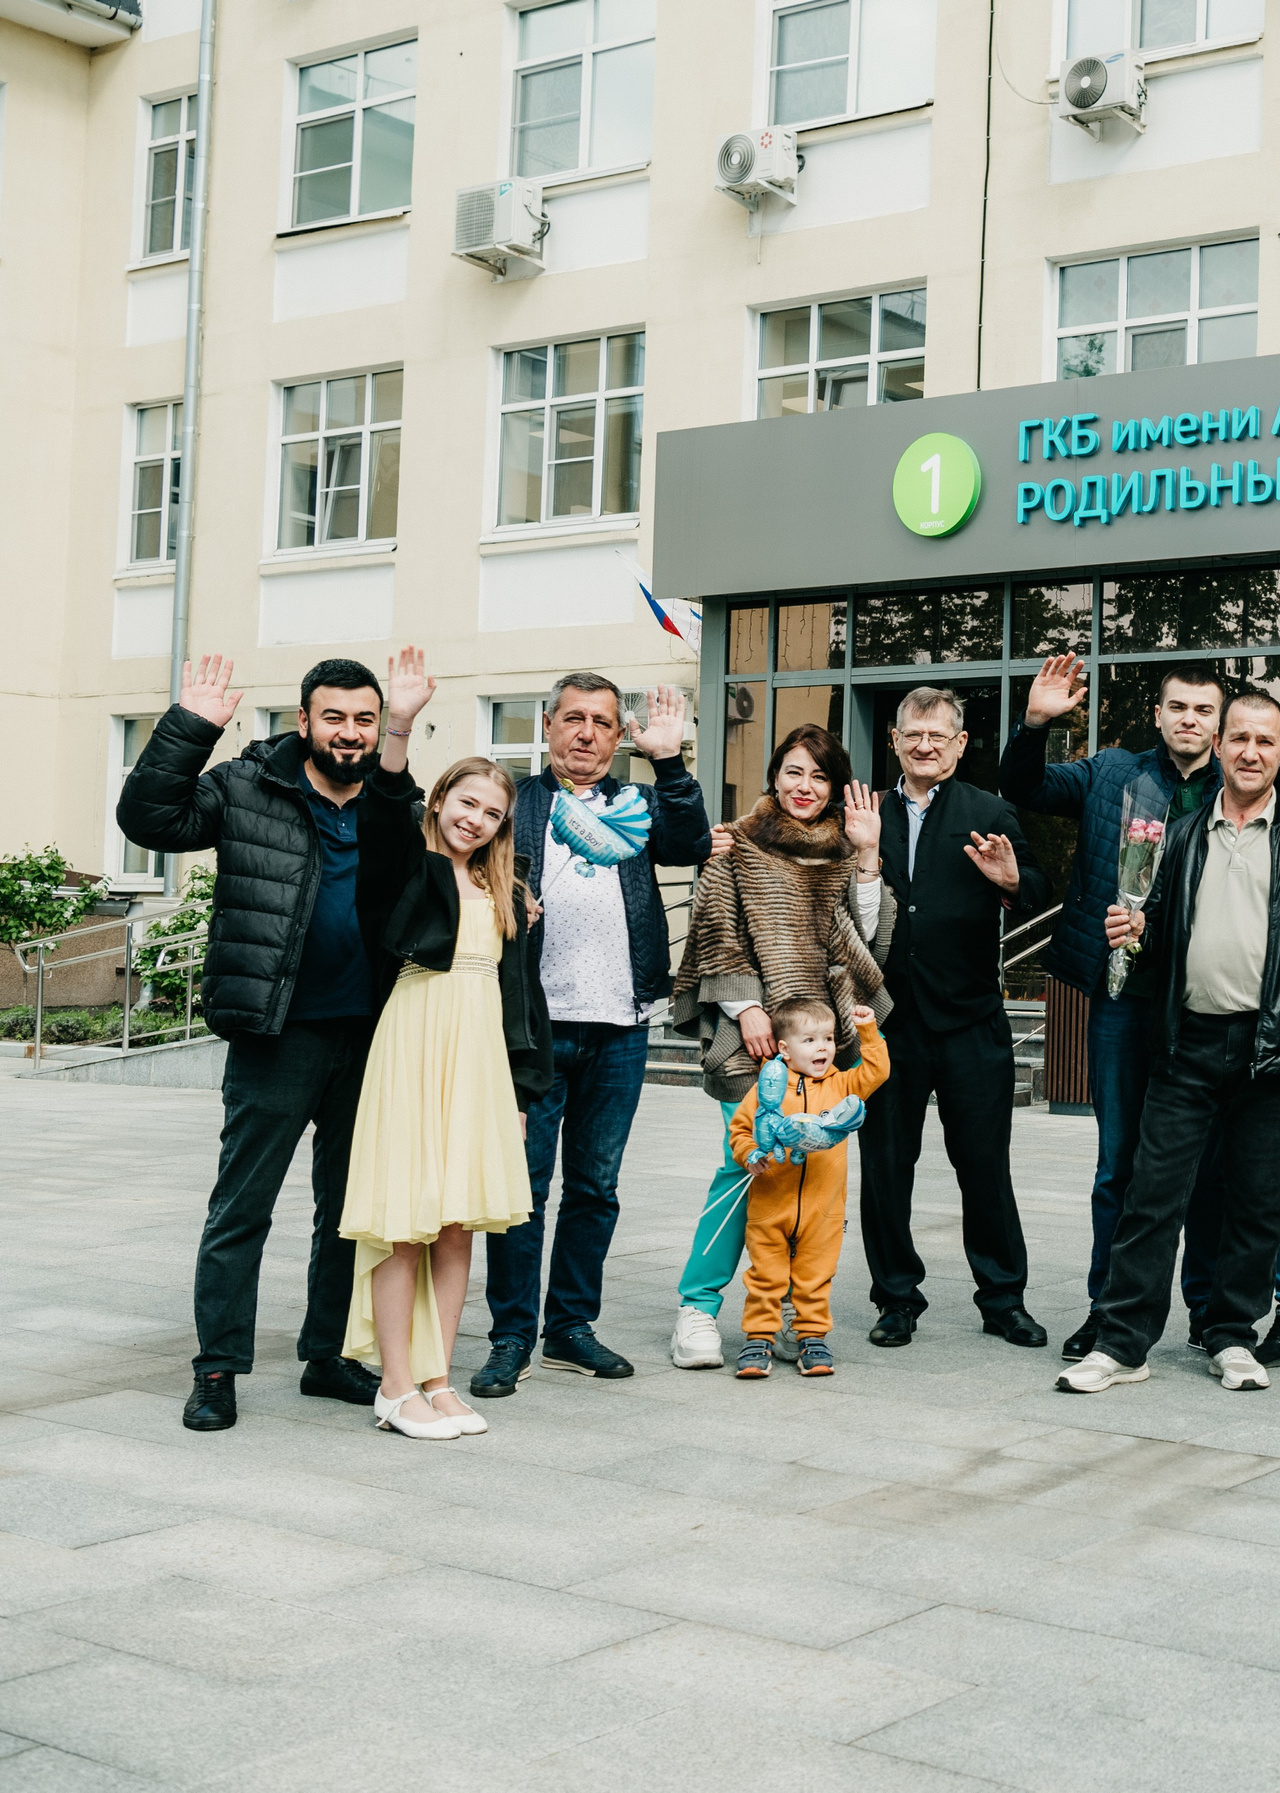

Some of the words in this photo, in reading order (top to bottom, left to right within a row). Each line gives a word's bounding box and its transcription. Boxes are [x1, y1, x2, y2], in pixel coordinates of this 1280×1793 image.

[1018, 412, 1100, 463] ГКБ
[1111, 405, 1260, 453] имени
[920, 453, 941, 514] 1
[919, 520, 945, 530] КОРПУС
